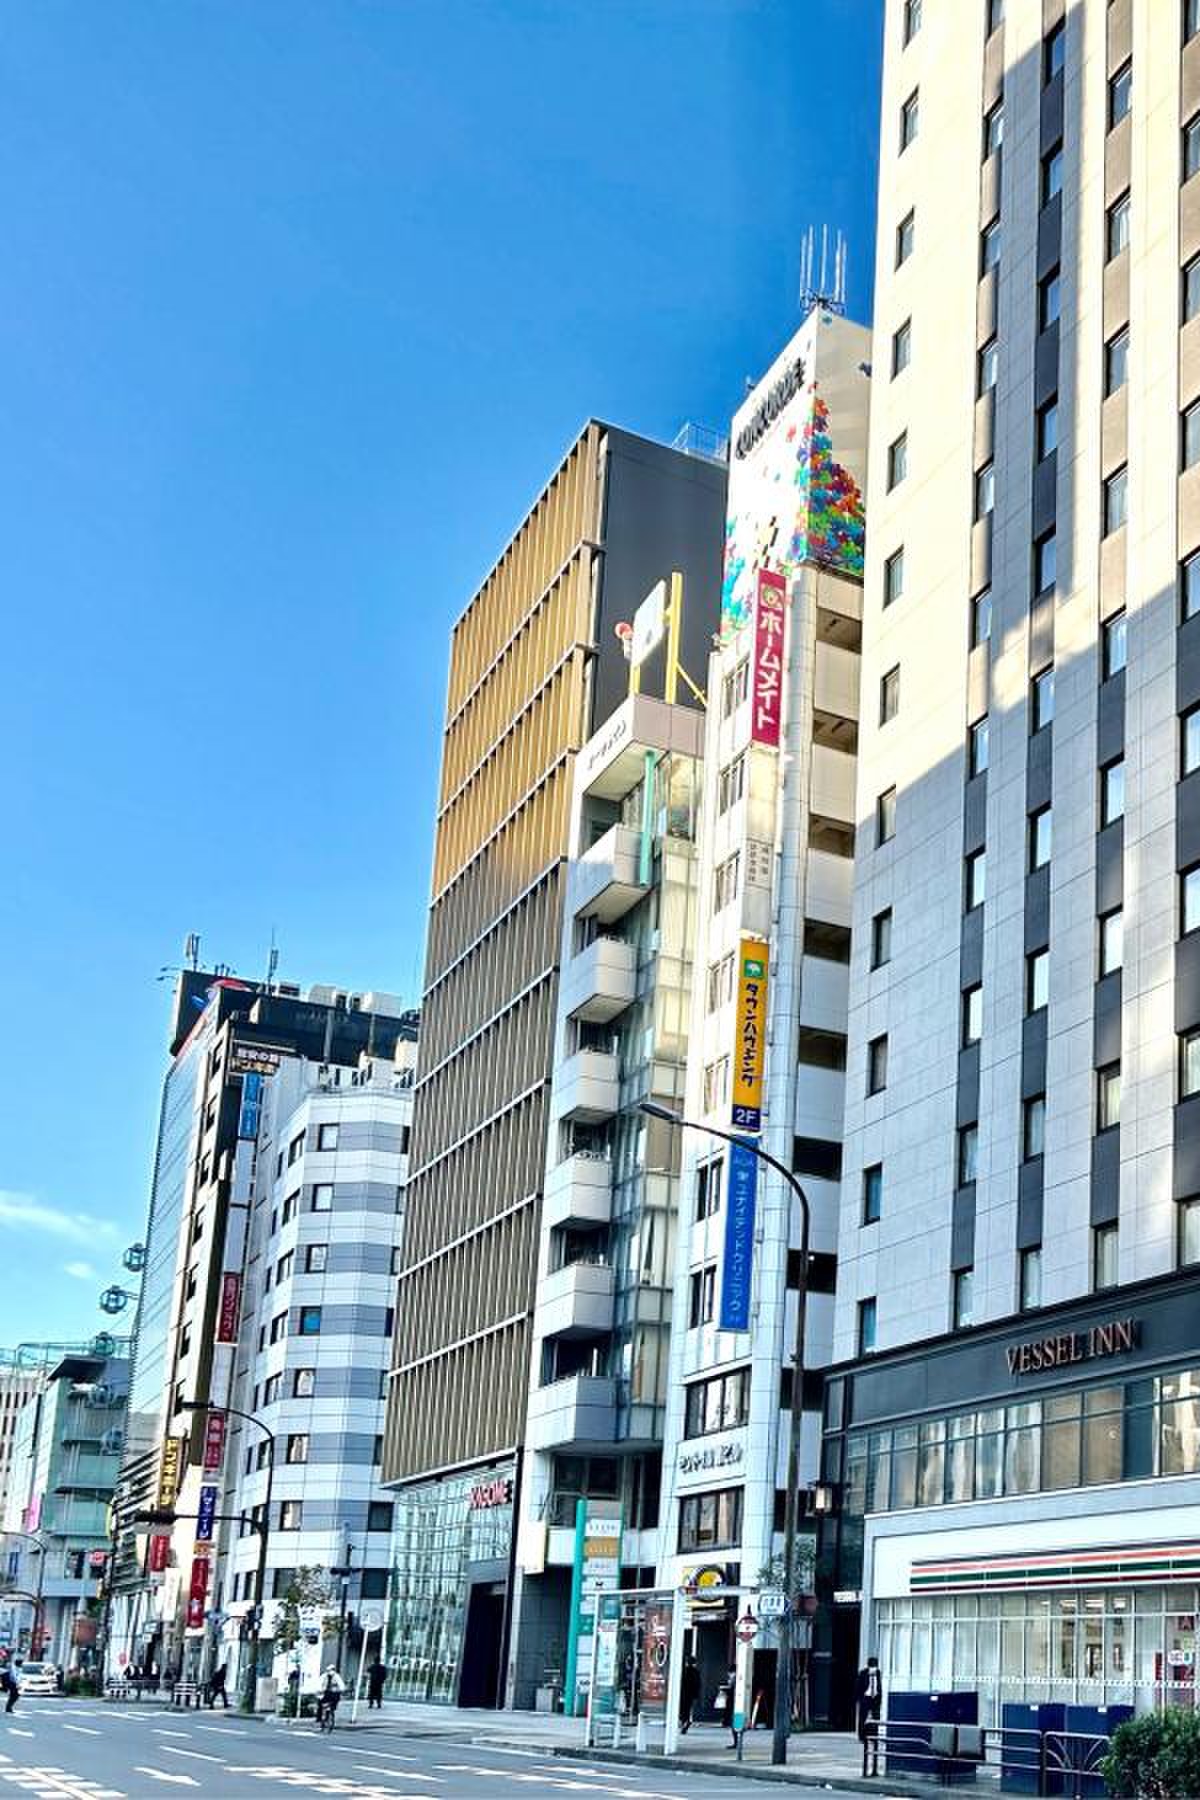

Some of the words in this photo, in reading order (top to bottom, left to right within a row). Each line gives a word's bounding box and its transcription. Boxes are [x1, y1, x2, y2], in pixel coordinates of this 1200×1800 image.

[757, 608, 782, 730] ホームメイト
[741, 982, 760, 1087] タウンハウジング
[735, 1108, 757, 1124] 2F
[1006, 1331, 1083, 1376] VESSEL
[1087, 1316, 1137, 1358] INN
